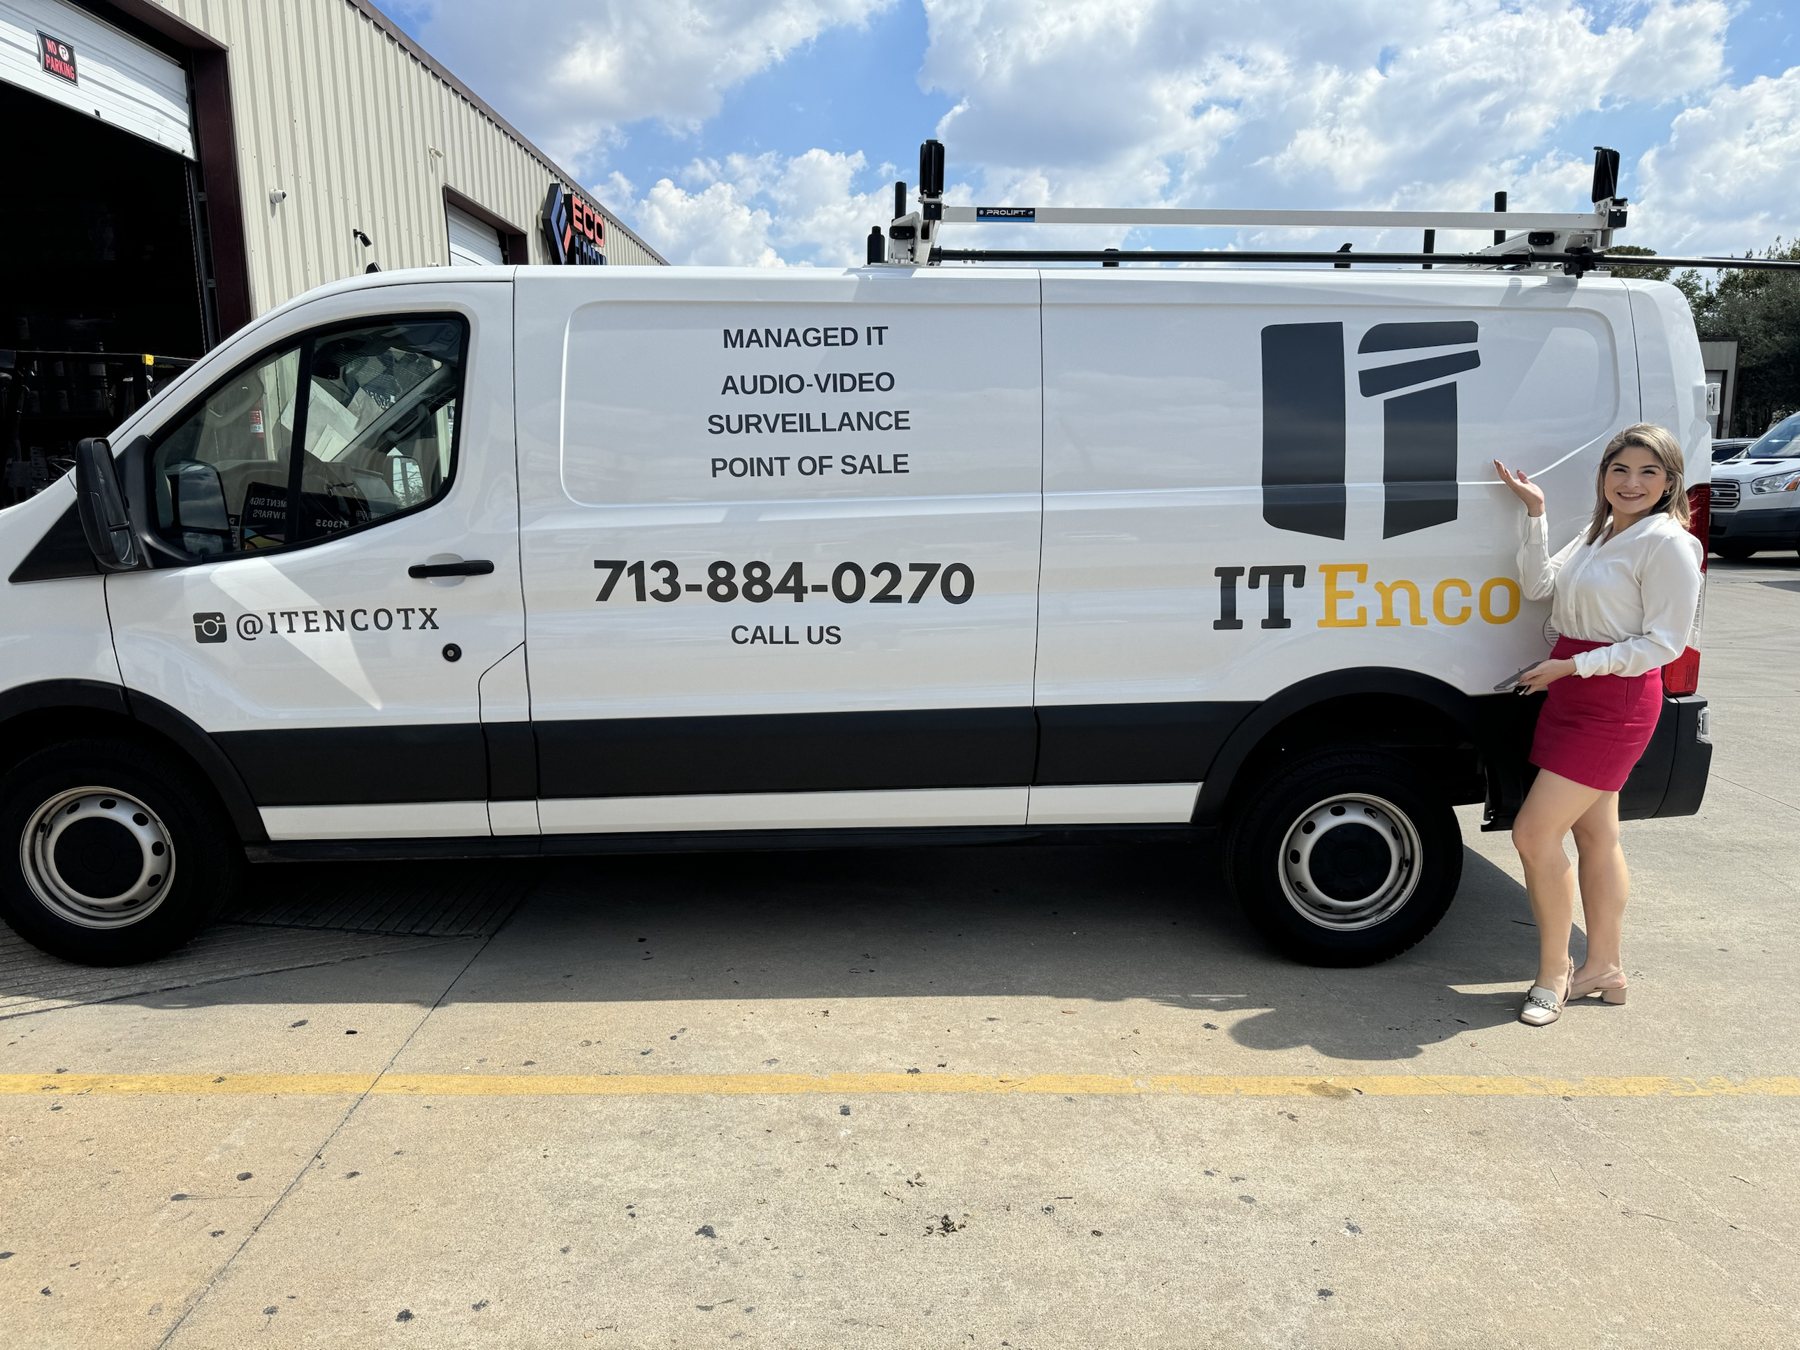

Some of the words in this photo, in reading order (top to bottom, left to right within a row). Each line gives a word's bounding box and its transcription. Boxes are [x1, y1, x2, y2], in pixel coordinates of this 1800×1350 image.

[45, 38, 57, 55] NO
[45, 54, 75, 79] PARKING
[572, 194, 605, 248] ECO
[724, 327, 859, 348] MANAGED
[867, 326, 889, 346] IT
[721, 372, 895, 395] AUDIO-VIDEO
[707, 410, 911, 434] SURVEILLANCE
[711, 456, 790, 478] POINT
[797, 455, 833, 476] OF
[840, 454, 910, 475] SALE
[594, 559, 975, 605] 713-884-0270
[1213, 564, 1307, 630] IT
[1317, 563, 1522, 627] Enco
[236, 607, 440, 641] @ITENCOTX
[731, 625, 799, 645] CALL
[807, 625, 842, 645] US
